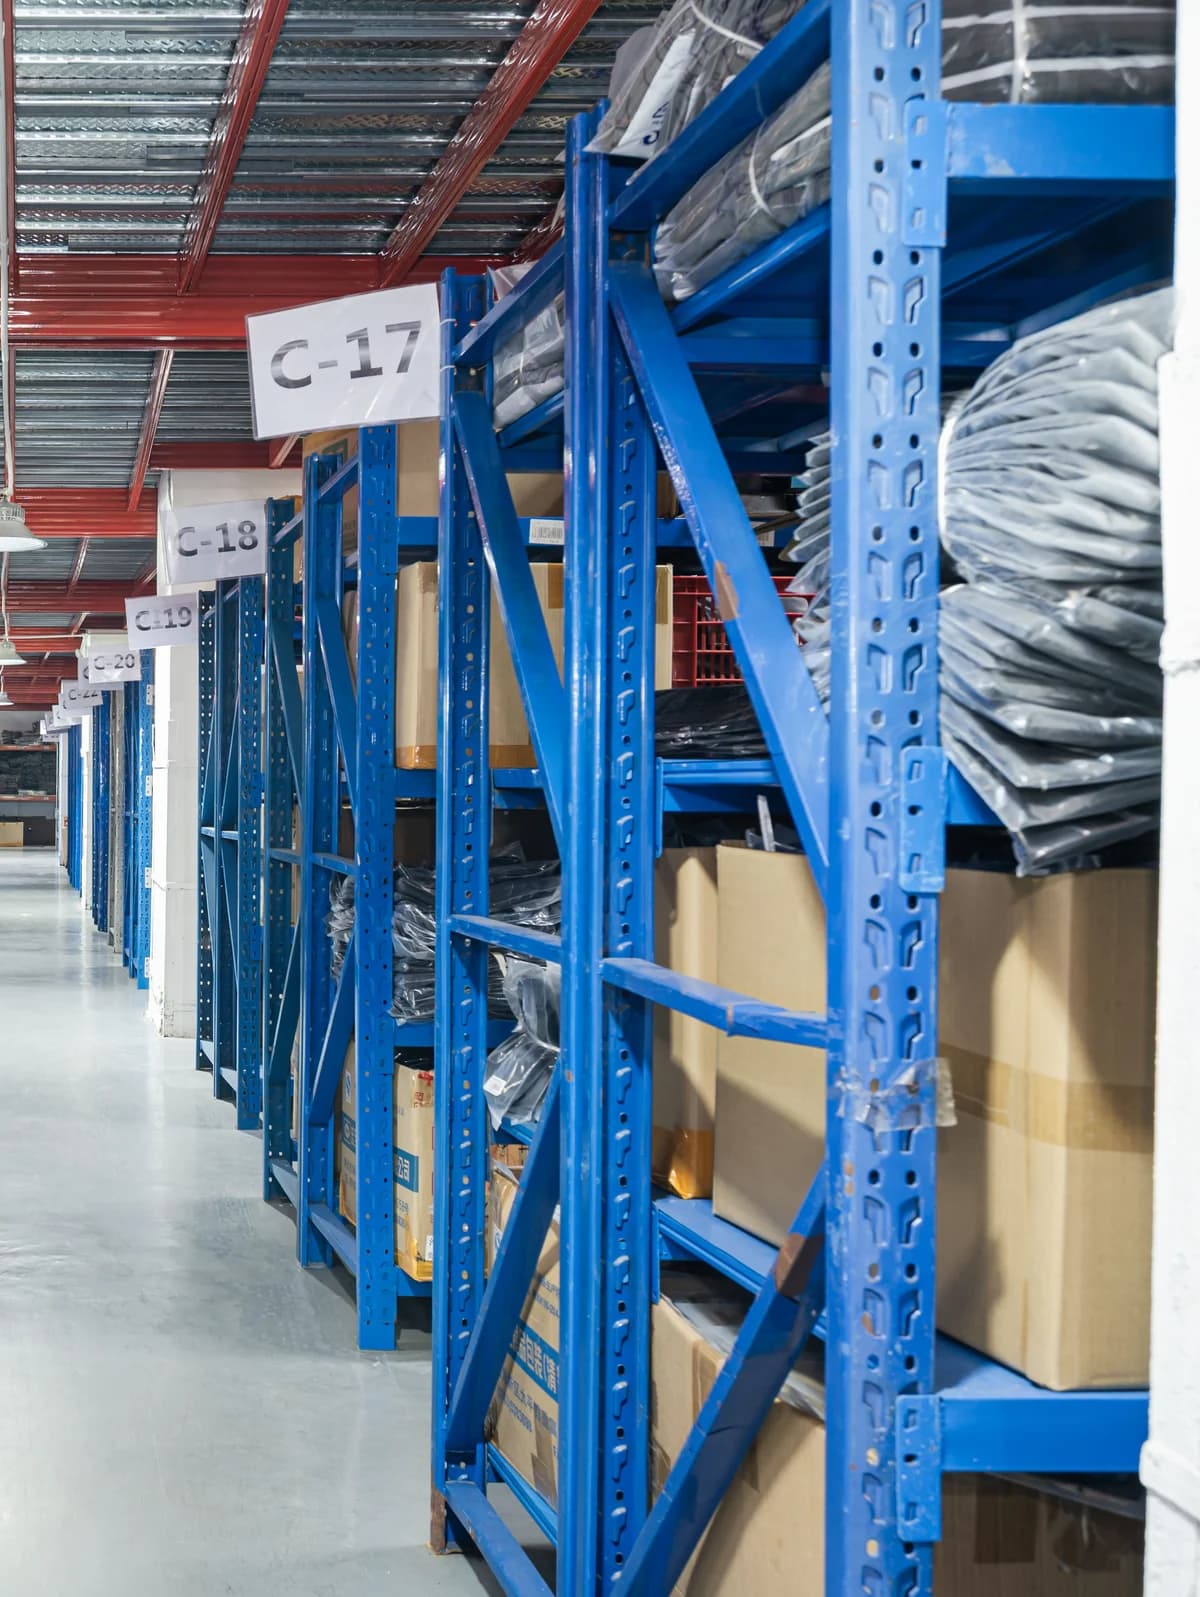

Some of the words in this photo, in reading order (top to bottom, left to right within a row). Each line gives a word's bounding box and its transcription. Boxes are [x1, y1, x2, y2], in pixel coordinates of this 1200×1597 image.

[270, 320, 422, 389] C-17
[176, 520, 259, 557] C-18
[135, 606, 193, 632] C-19
[94, 653, 136, 671] C-20
